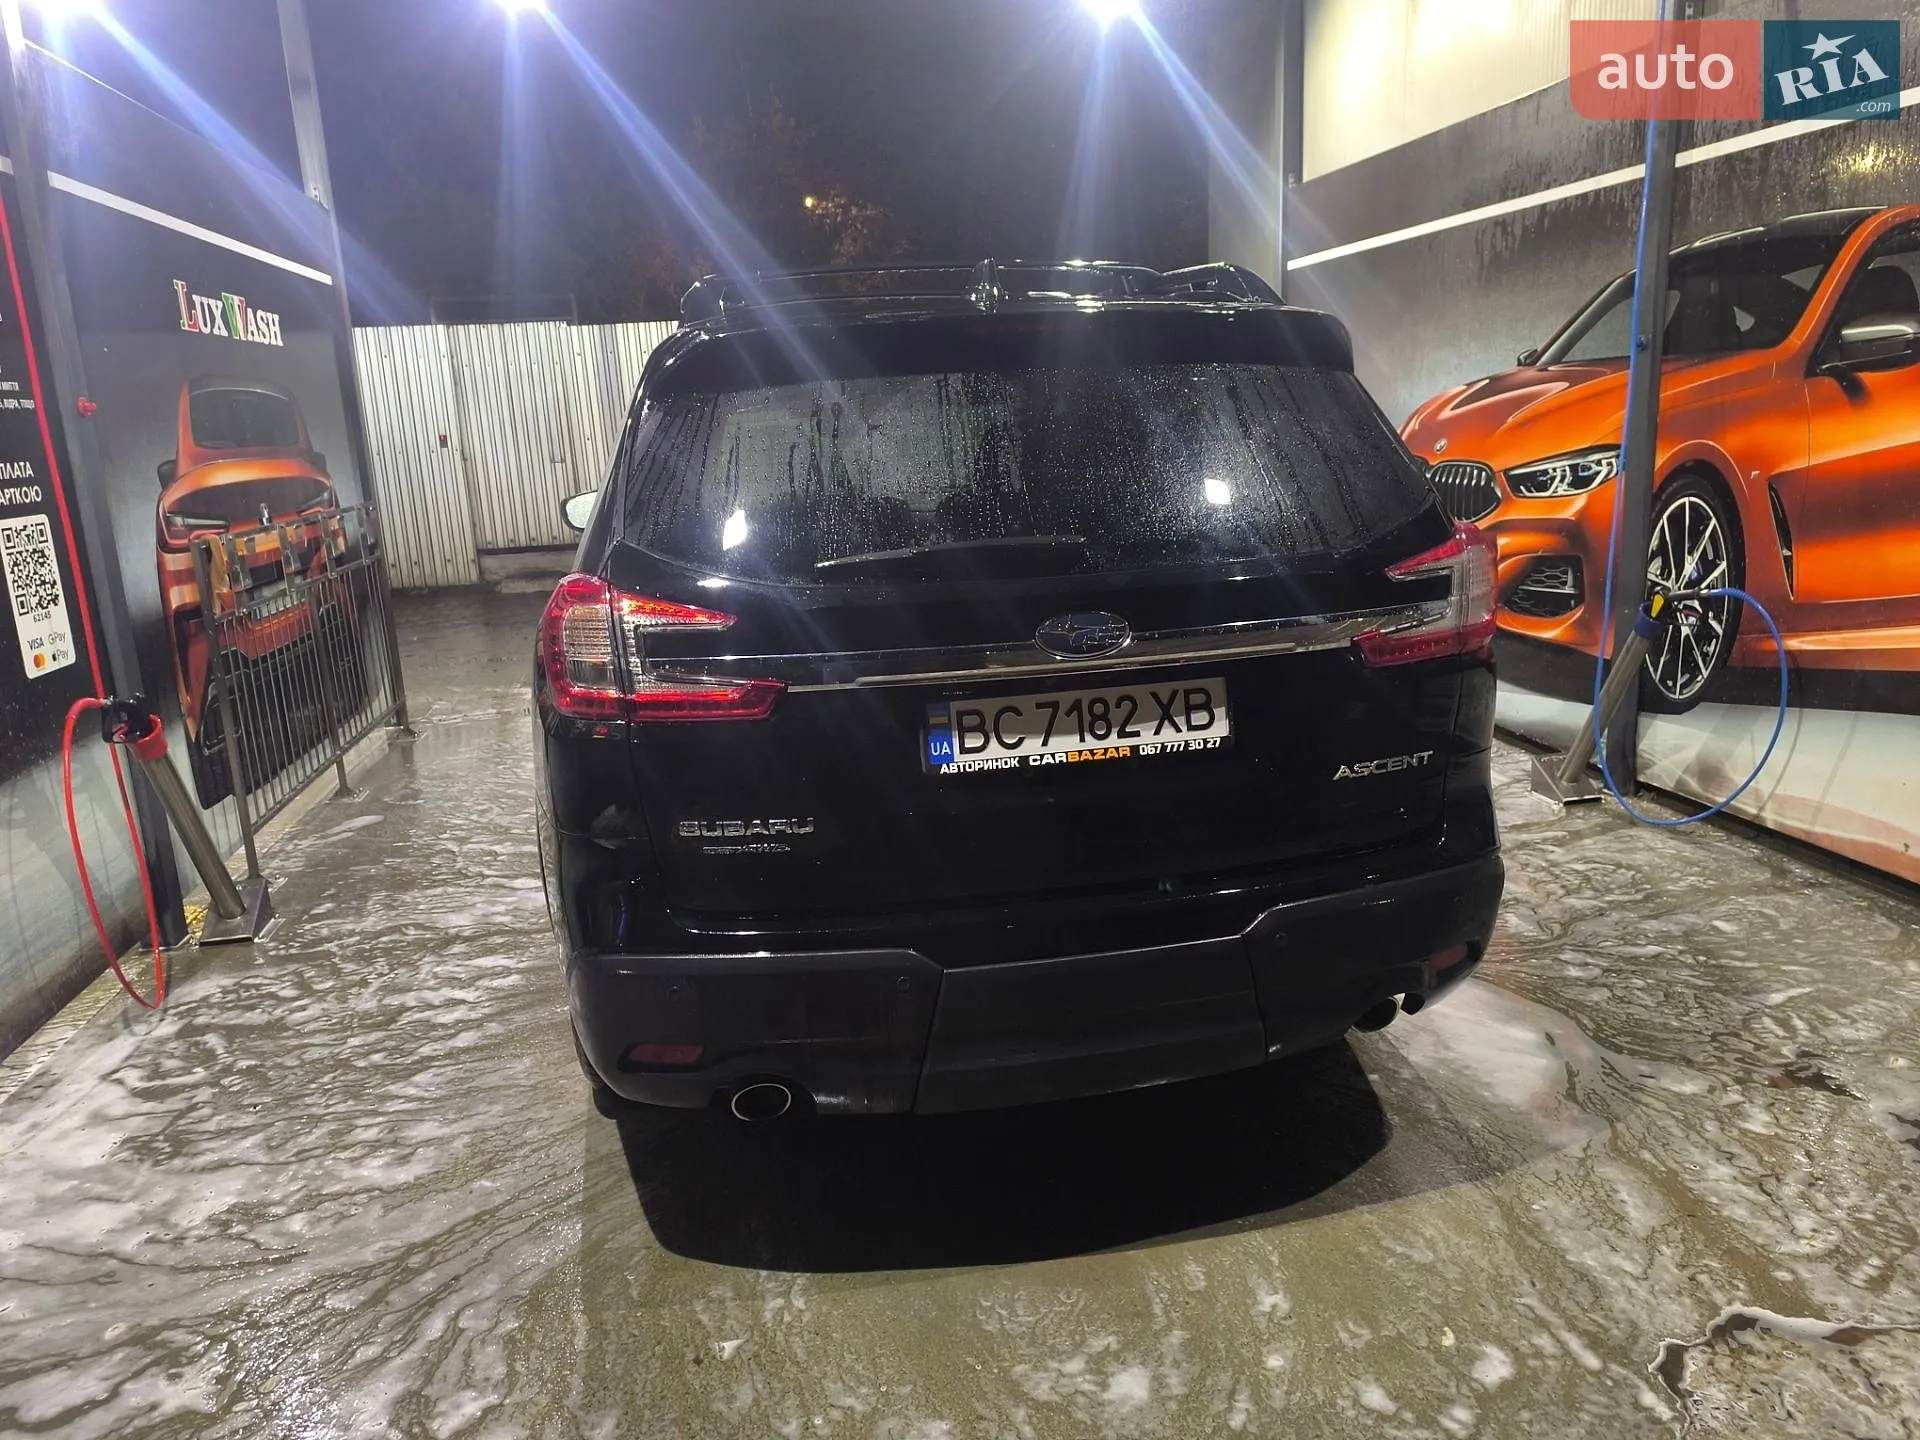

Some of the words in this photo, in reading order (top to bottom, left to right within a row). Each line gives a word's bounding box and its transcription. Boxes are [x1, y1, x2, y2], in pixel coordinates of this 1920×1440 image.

[27, 636, 45, 650] VISA
[1035, 694, 1141, 747] 7182
[930, 741, 951, 756] UA
[940, 756, 1020, 775] АВТОРИНОК
[1139, 743, 1161, 756] 067
[1165, 740, 1185, 753] 777
[1188, 739, 1203, 750] 30
[1206, 737, 1221, 748] 27
[1333, 750, 1434, 780] ASCENT
[679, 817, 814, 836] SUBARU
